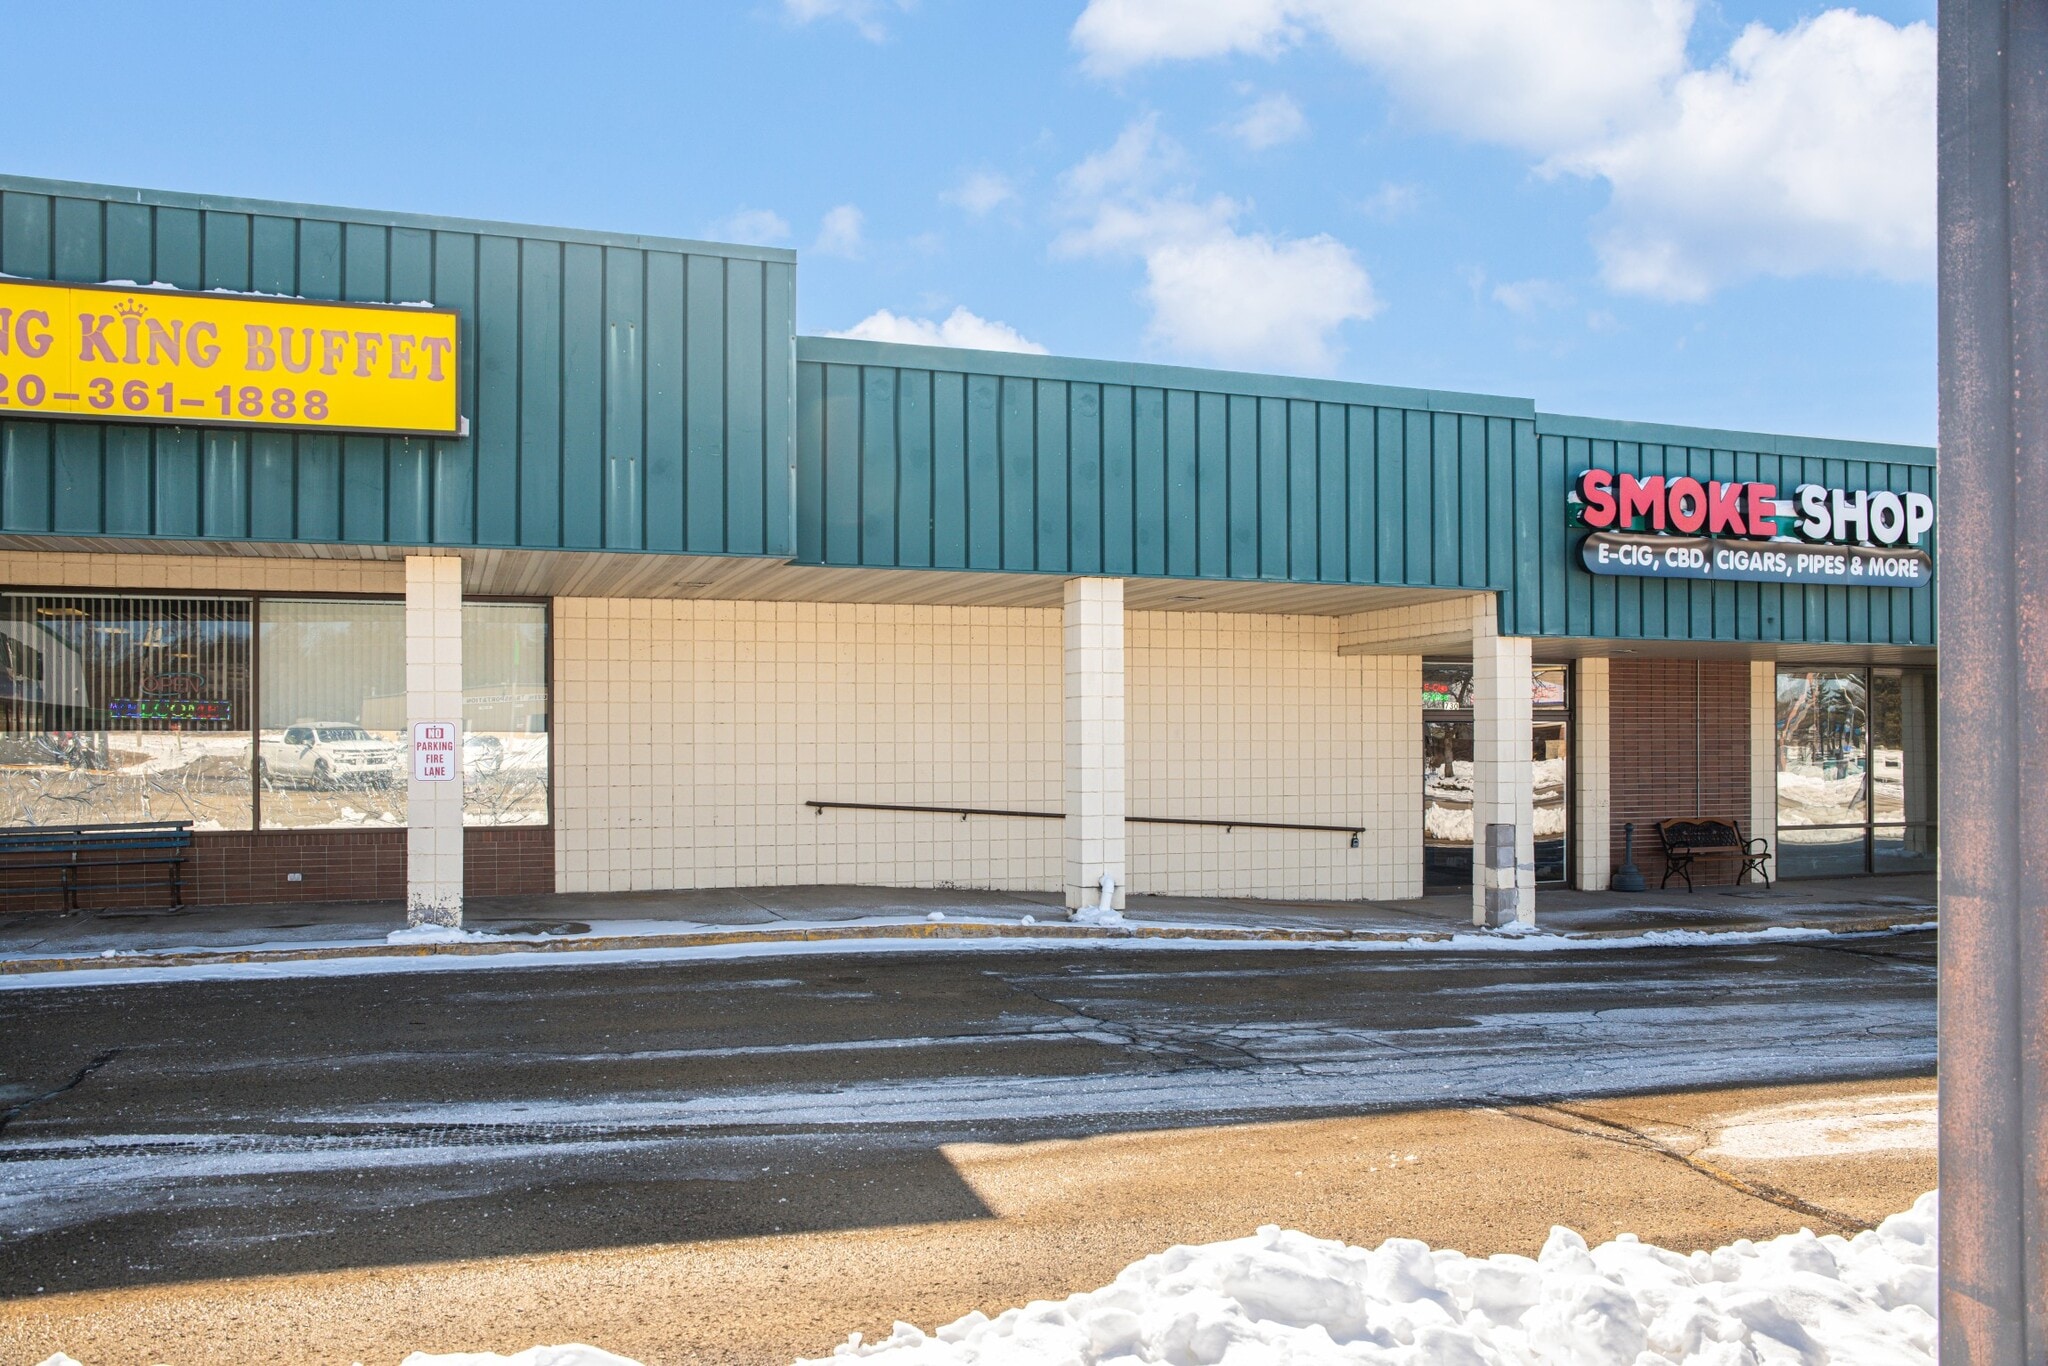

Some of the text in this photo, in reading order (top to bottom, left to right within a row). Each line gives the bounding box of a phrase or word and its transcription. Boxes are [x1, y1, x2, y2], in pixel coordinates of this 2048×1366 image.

[79, 313, 221, 368] KING
[245, 324, 452, 382] BUFFET
[1582, 469, 1934, 544] SMOKE SHOP
[1598, 544, 1919, 578] E-CIG, CBD, CIGARS, PIPES & MORE
[143, 677, 200, 692] OPEN
[427, 728, 442, 739] NO
[416, 742, 453, 751] PARKING
[426, 754, 444, 763] FIRE
[424, 767, 445, 776] LANE
